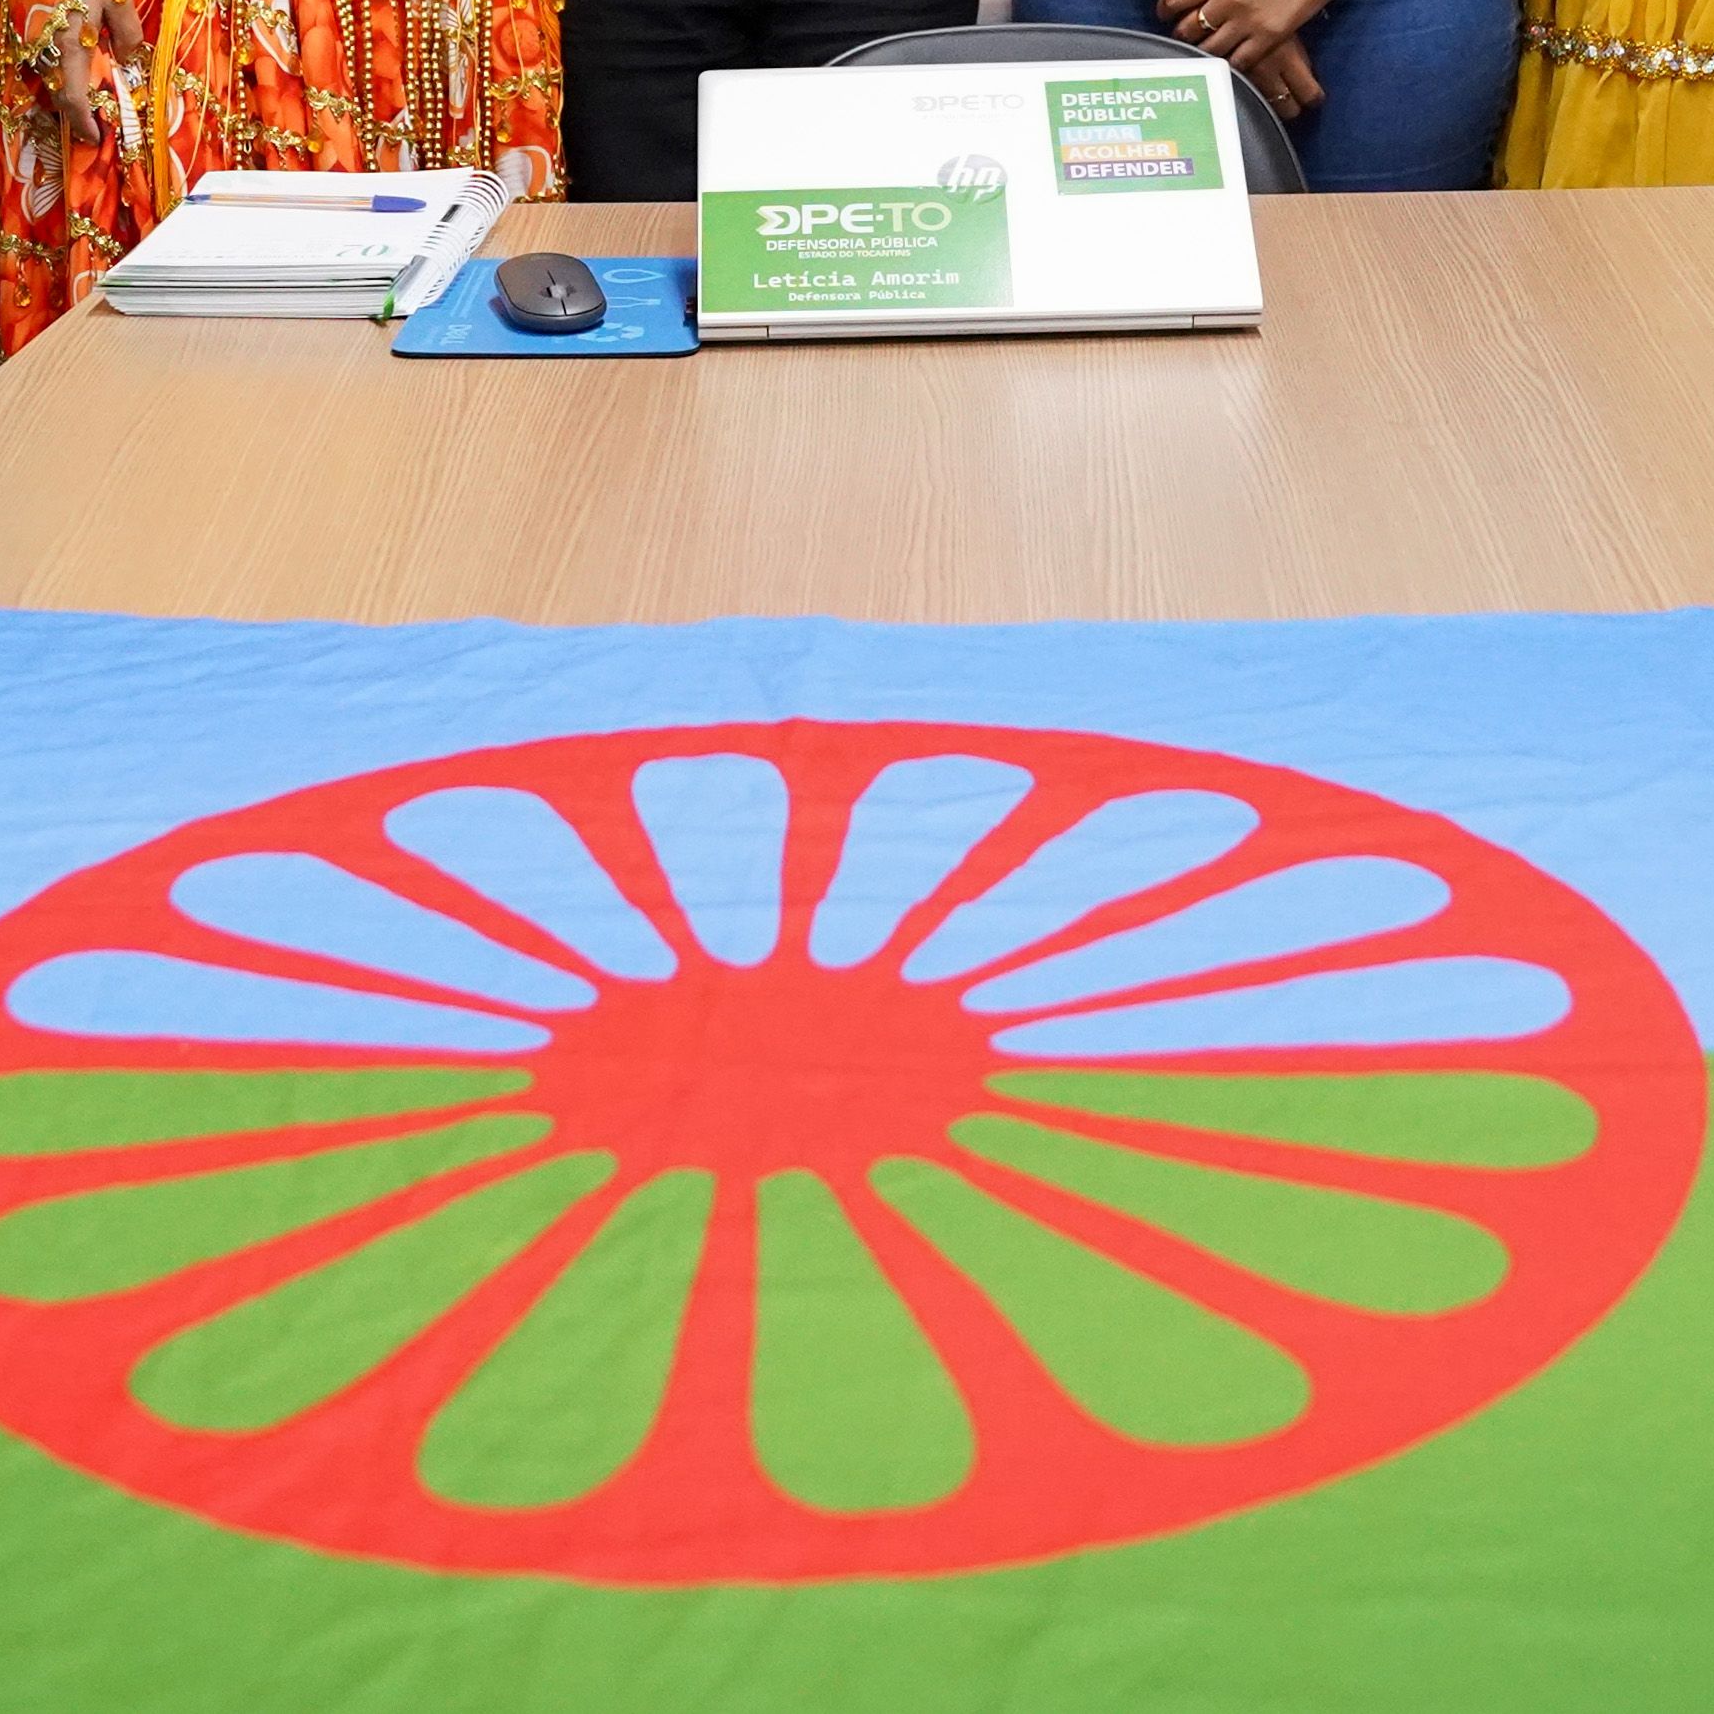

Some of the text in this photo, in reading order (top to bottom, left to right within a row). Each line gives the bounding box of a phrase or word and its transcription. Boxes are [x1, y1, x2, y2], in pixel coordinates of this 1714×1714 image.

[1061, 88, 1199, 106] DEFENSORIA
[1062, 105, 1158, 123] PÚBLICA
[1065, 126, 1136, 142] LUTAR
[1069, 143, 1171, 160] ACOLHER
[946, 154, 1002, 202] hp
[1070, 161, 1187, 179] DEFENDER
[766, 235, 939, 252] DEFENSORIA PÚBLICA
[798, 249, 912, 260] ESTADO DO TOCANTINS
[753, 269, 960, 289] Letícia Amorim
[788, 289, 927, 302] Defensora Pública
